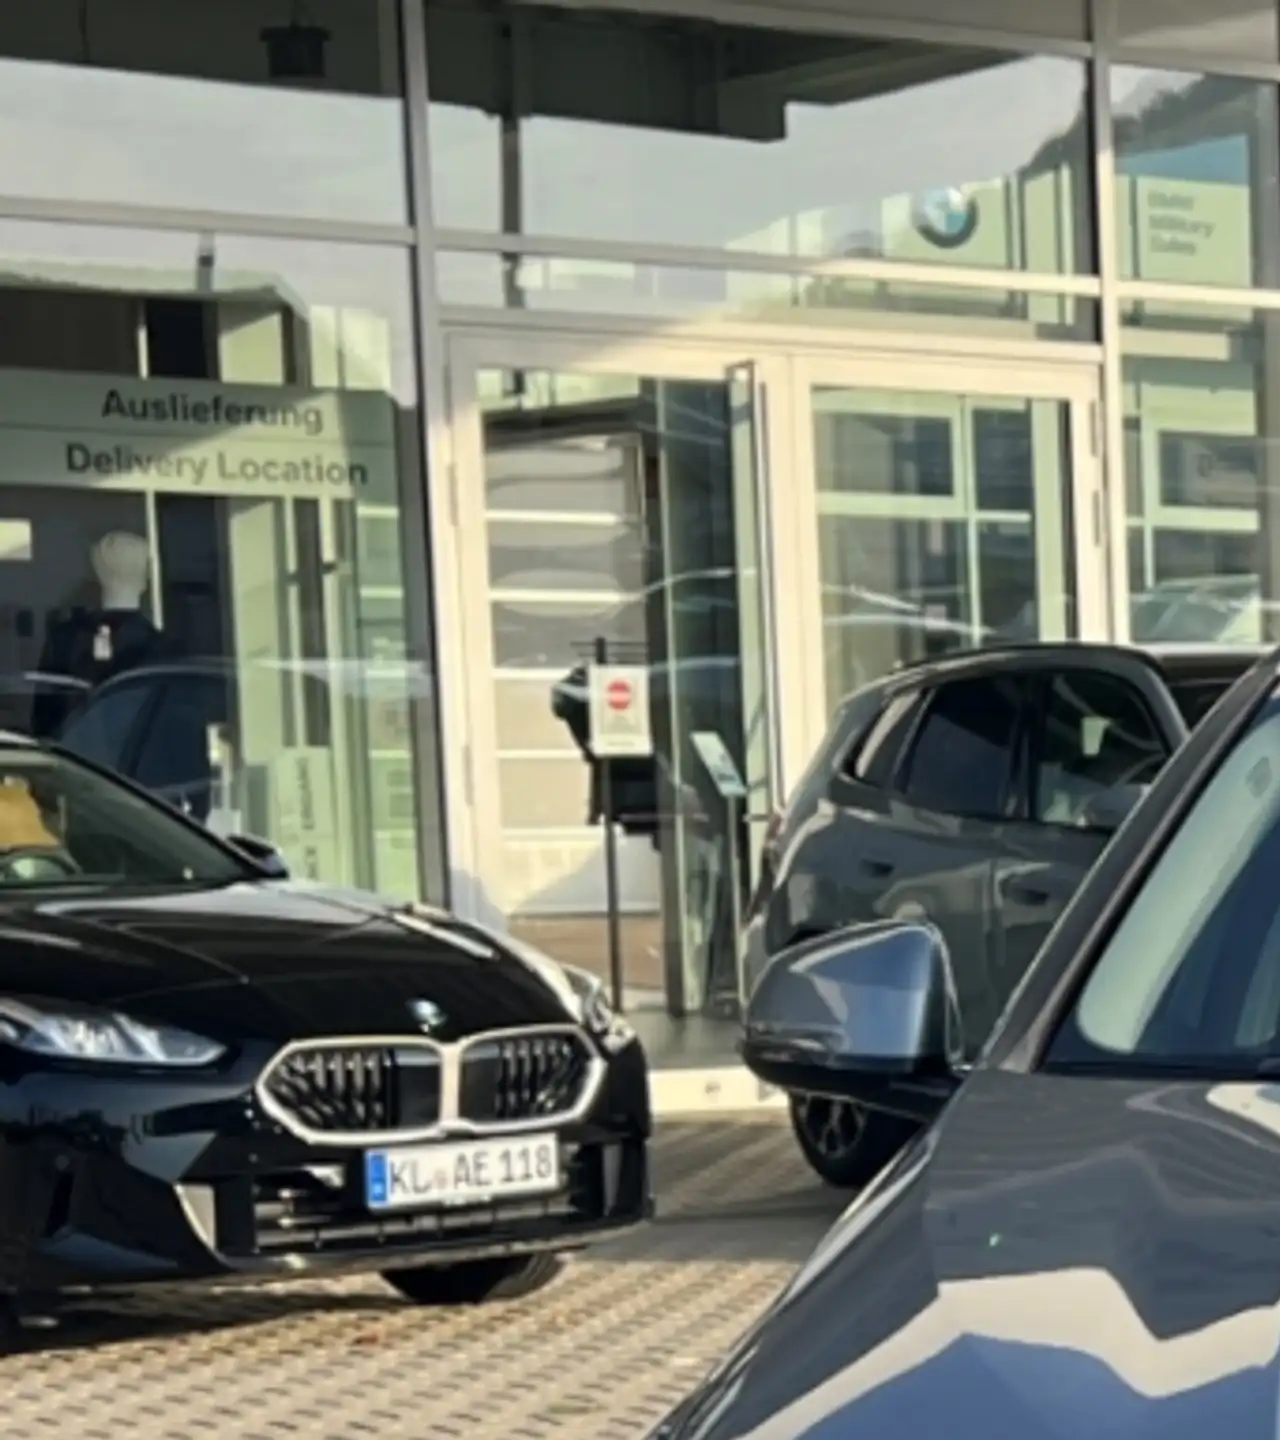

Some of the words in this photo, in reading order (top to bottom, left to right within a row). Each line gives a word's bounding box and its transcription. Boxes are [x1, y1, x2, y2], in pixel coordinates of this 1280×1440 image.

[101, 388, 325, 434] Auslieferung
[66, 442, 209, 485] Delivery
[217, 451, 369, 486] Location
[389, 1159, 431, 1194] KL
[453, 1151, 492, 1188] AE
[498, 1144, 553, 1183] 118
